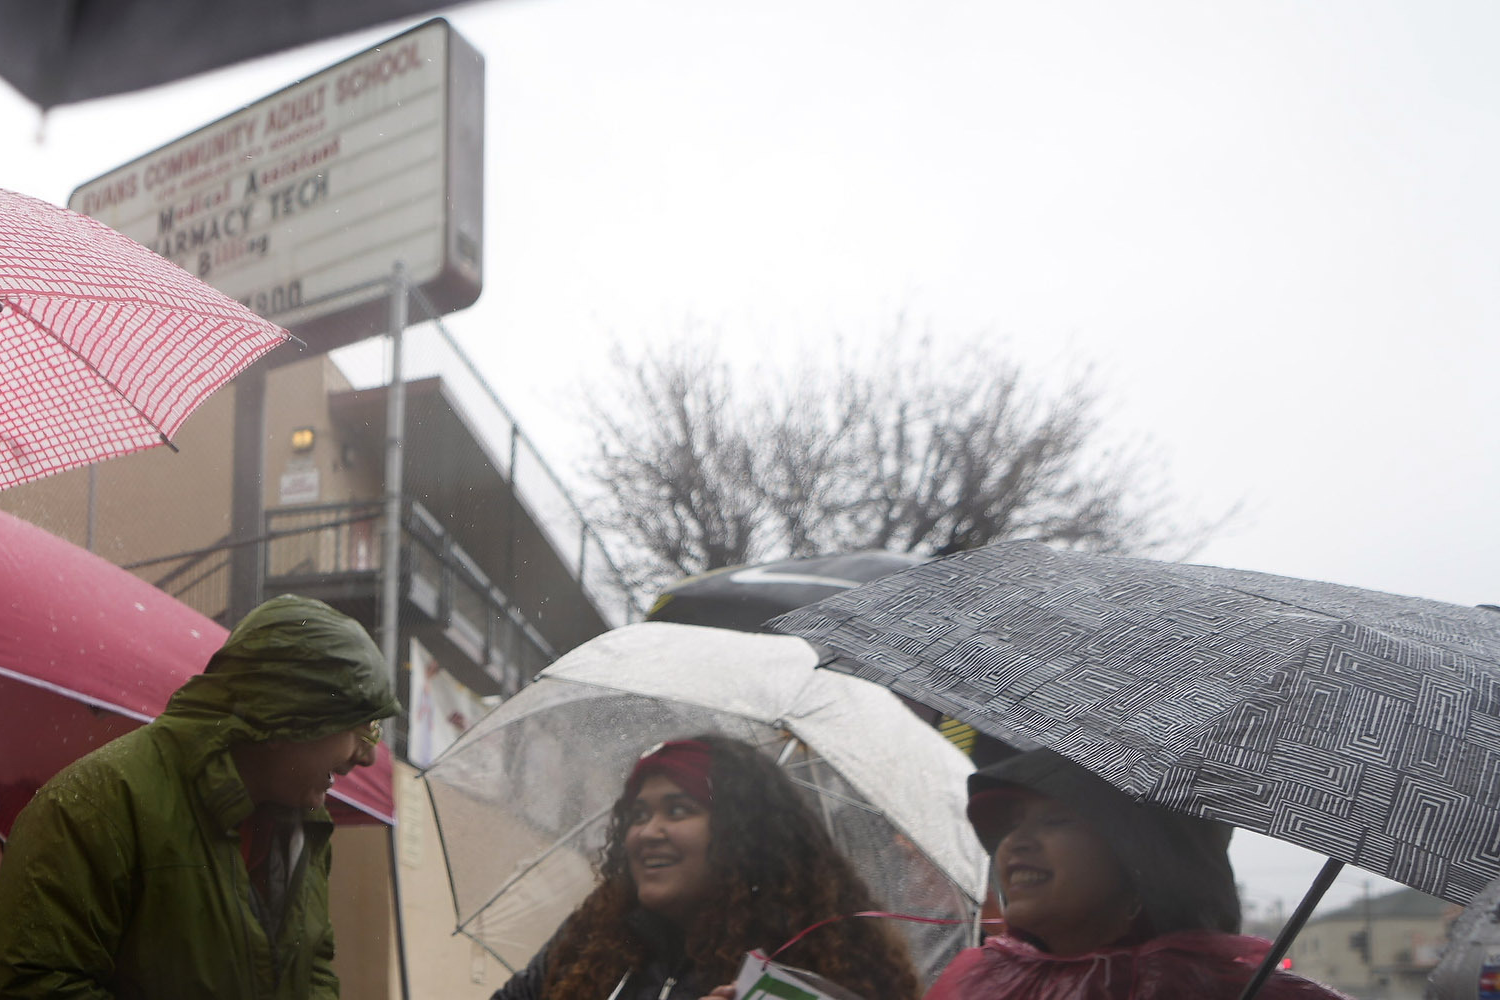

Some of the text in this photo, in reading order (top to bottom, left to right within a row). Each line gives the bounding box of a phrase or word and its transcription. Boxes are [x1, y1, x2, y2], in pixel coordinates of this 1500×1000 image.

[82, 172, 138, 216] EVANS
[143, 117, 258, 191] COMMUNITY
[263, 81, 327, 135] ADULT
[334, 41, 423, 106] SCHOOL
[158, 182, 231, 234] Medical
